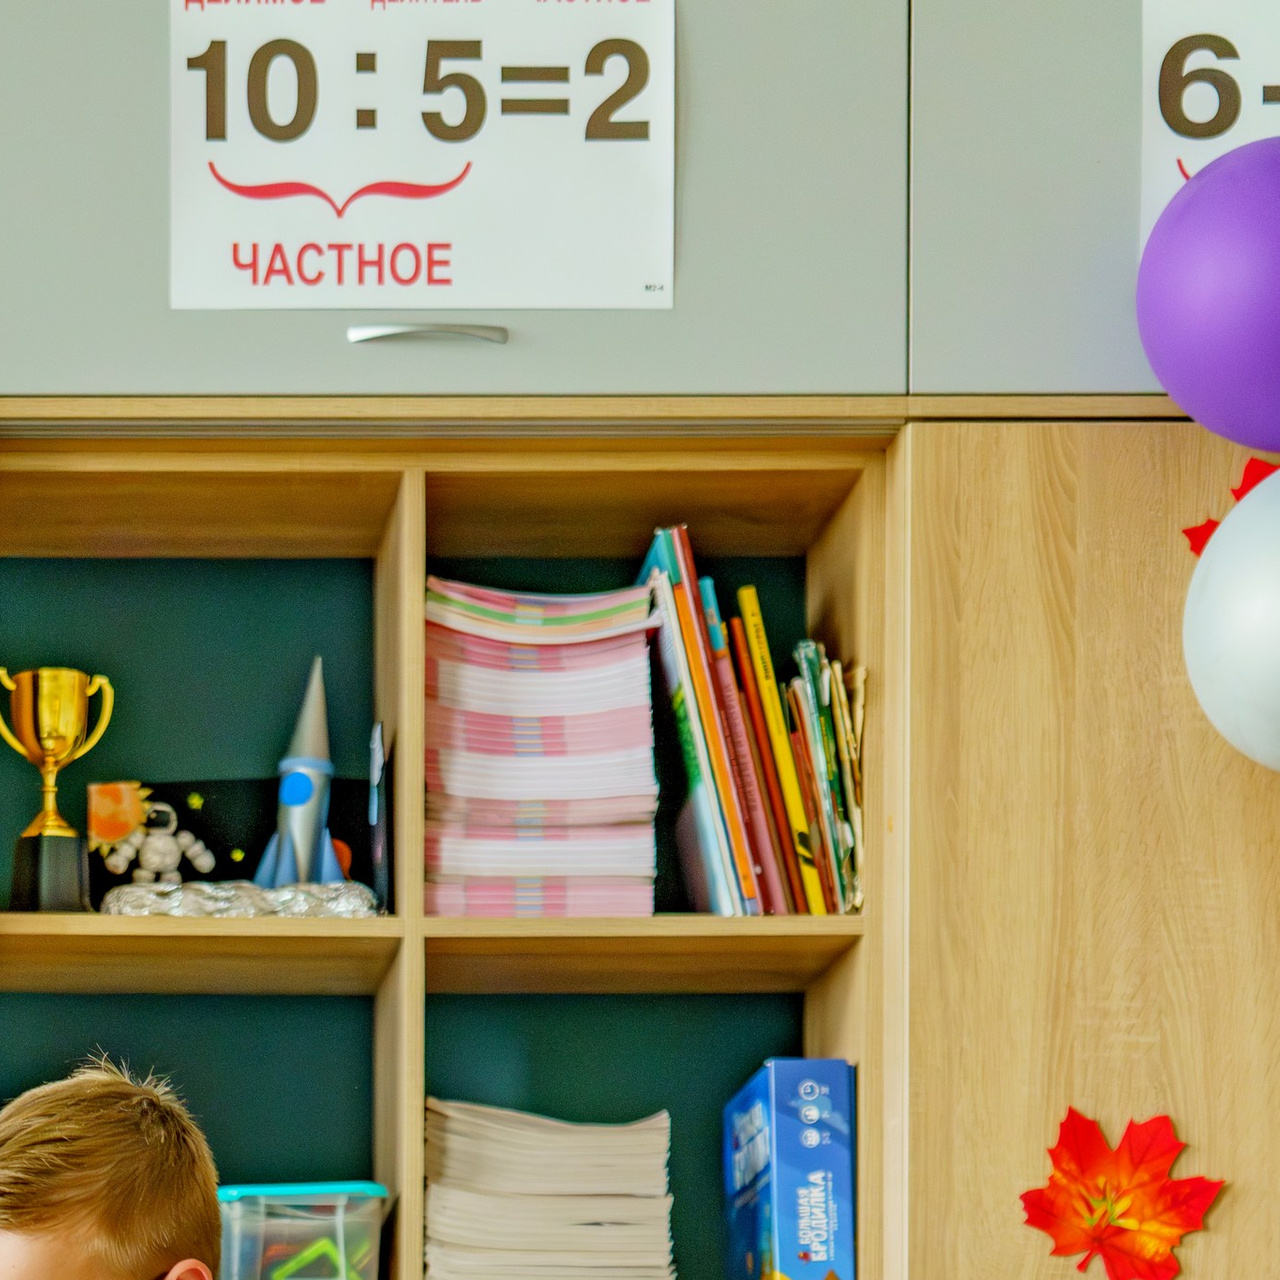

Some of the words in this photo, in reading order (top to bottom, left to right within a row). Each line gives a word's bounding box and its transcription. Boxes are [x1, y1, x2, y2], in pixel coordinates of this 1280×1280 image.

[231, 241, 454, 287] ЧАСТНОЕ
[797, 1186, 812, 1245] БОЛЬШАЯ
[808, 1170, 828, 1262] БРОДИЛКА
